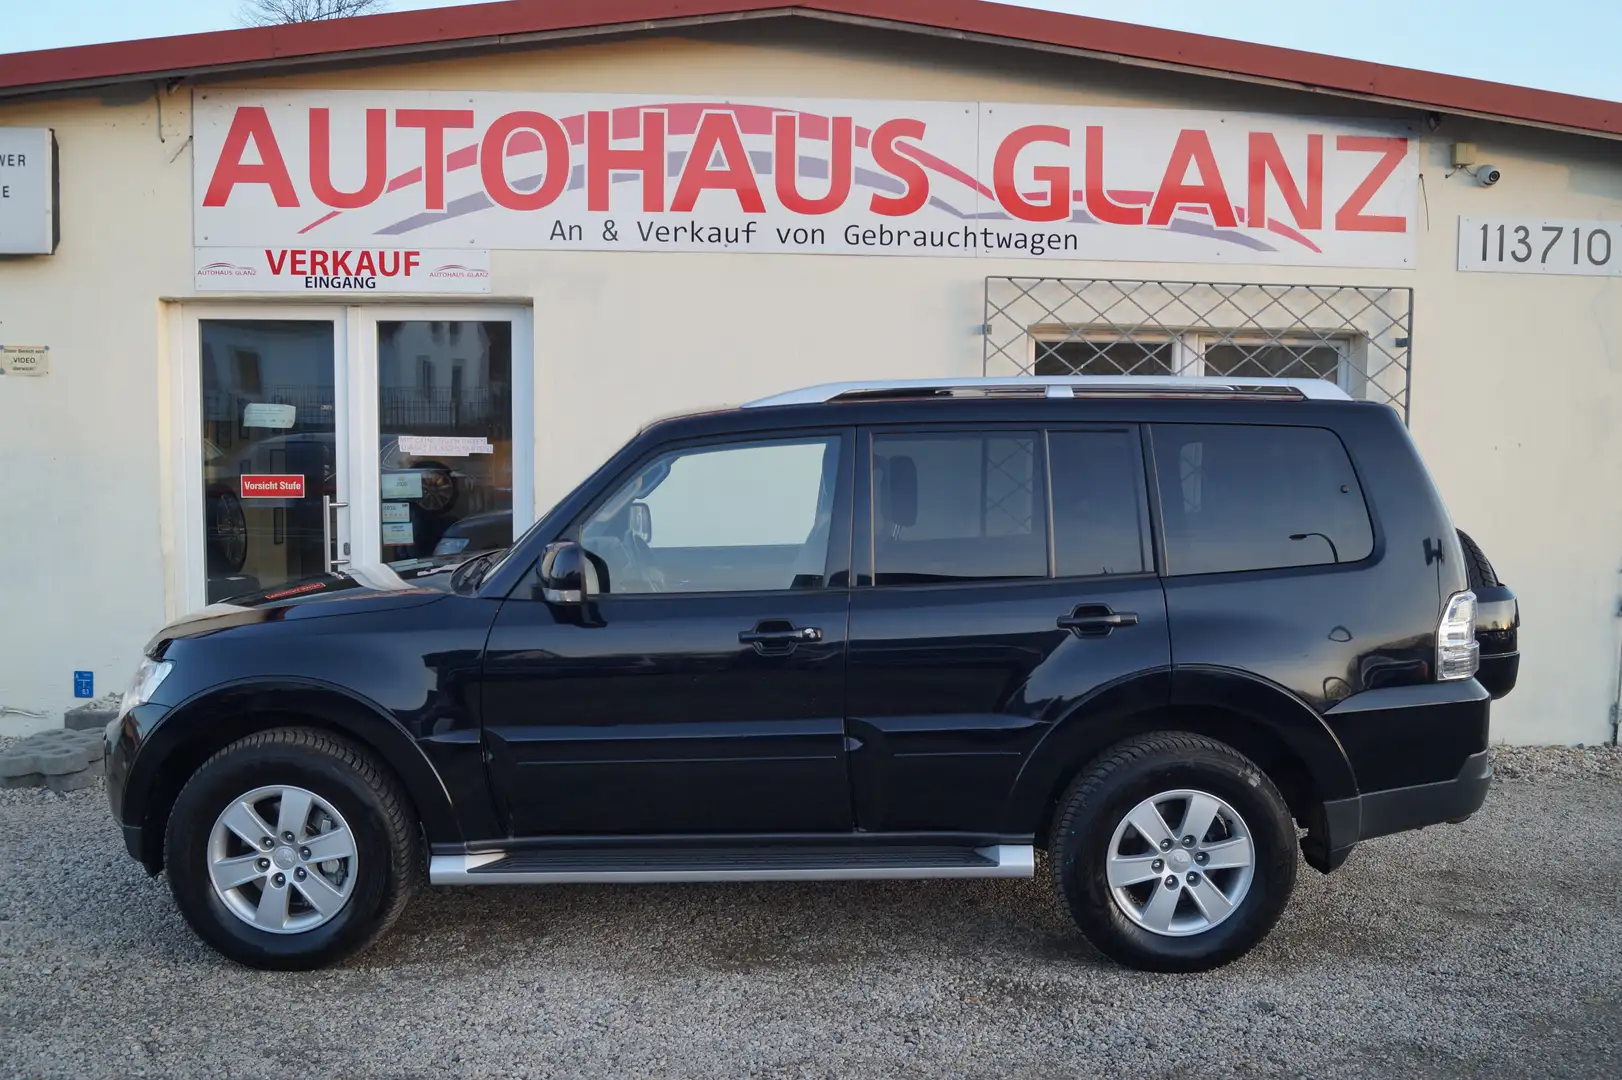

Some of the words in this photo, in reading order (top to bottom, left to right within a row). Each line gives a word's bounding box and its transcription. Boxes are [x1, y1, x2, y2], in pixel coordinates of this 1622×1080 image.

[202, 106, 929, 217] AUTOHAUS
[993, 124, 1409, 233] GLANZ
[549, 219, 583, 241] An
[602, 219, 619, 242] &
[637, 220, 757, 246] Verkauf
[776, 227, 825, 245] von
[844, 223, 1078, 256] Gebrauchtwagen
[1479, 223, 1612, 266] 113710
[264, 249, 420, 277] VERKAUF
[305, 276, 376, 289] EINGANG
[244, 481, 278, 491] Vorsicht
[279, 481, 301, 491] Stufe
